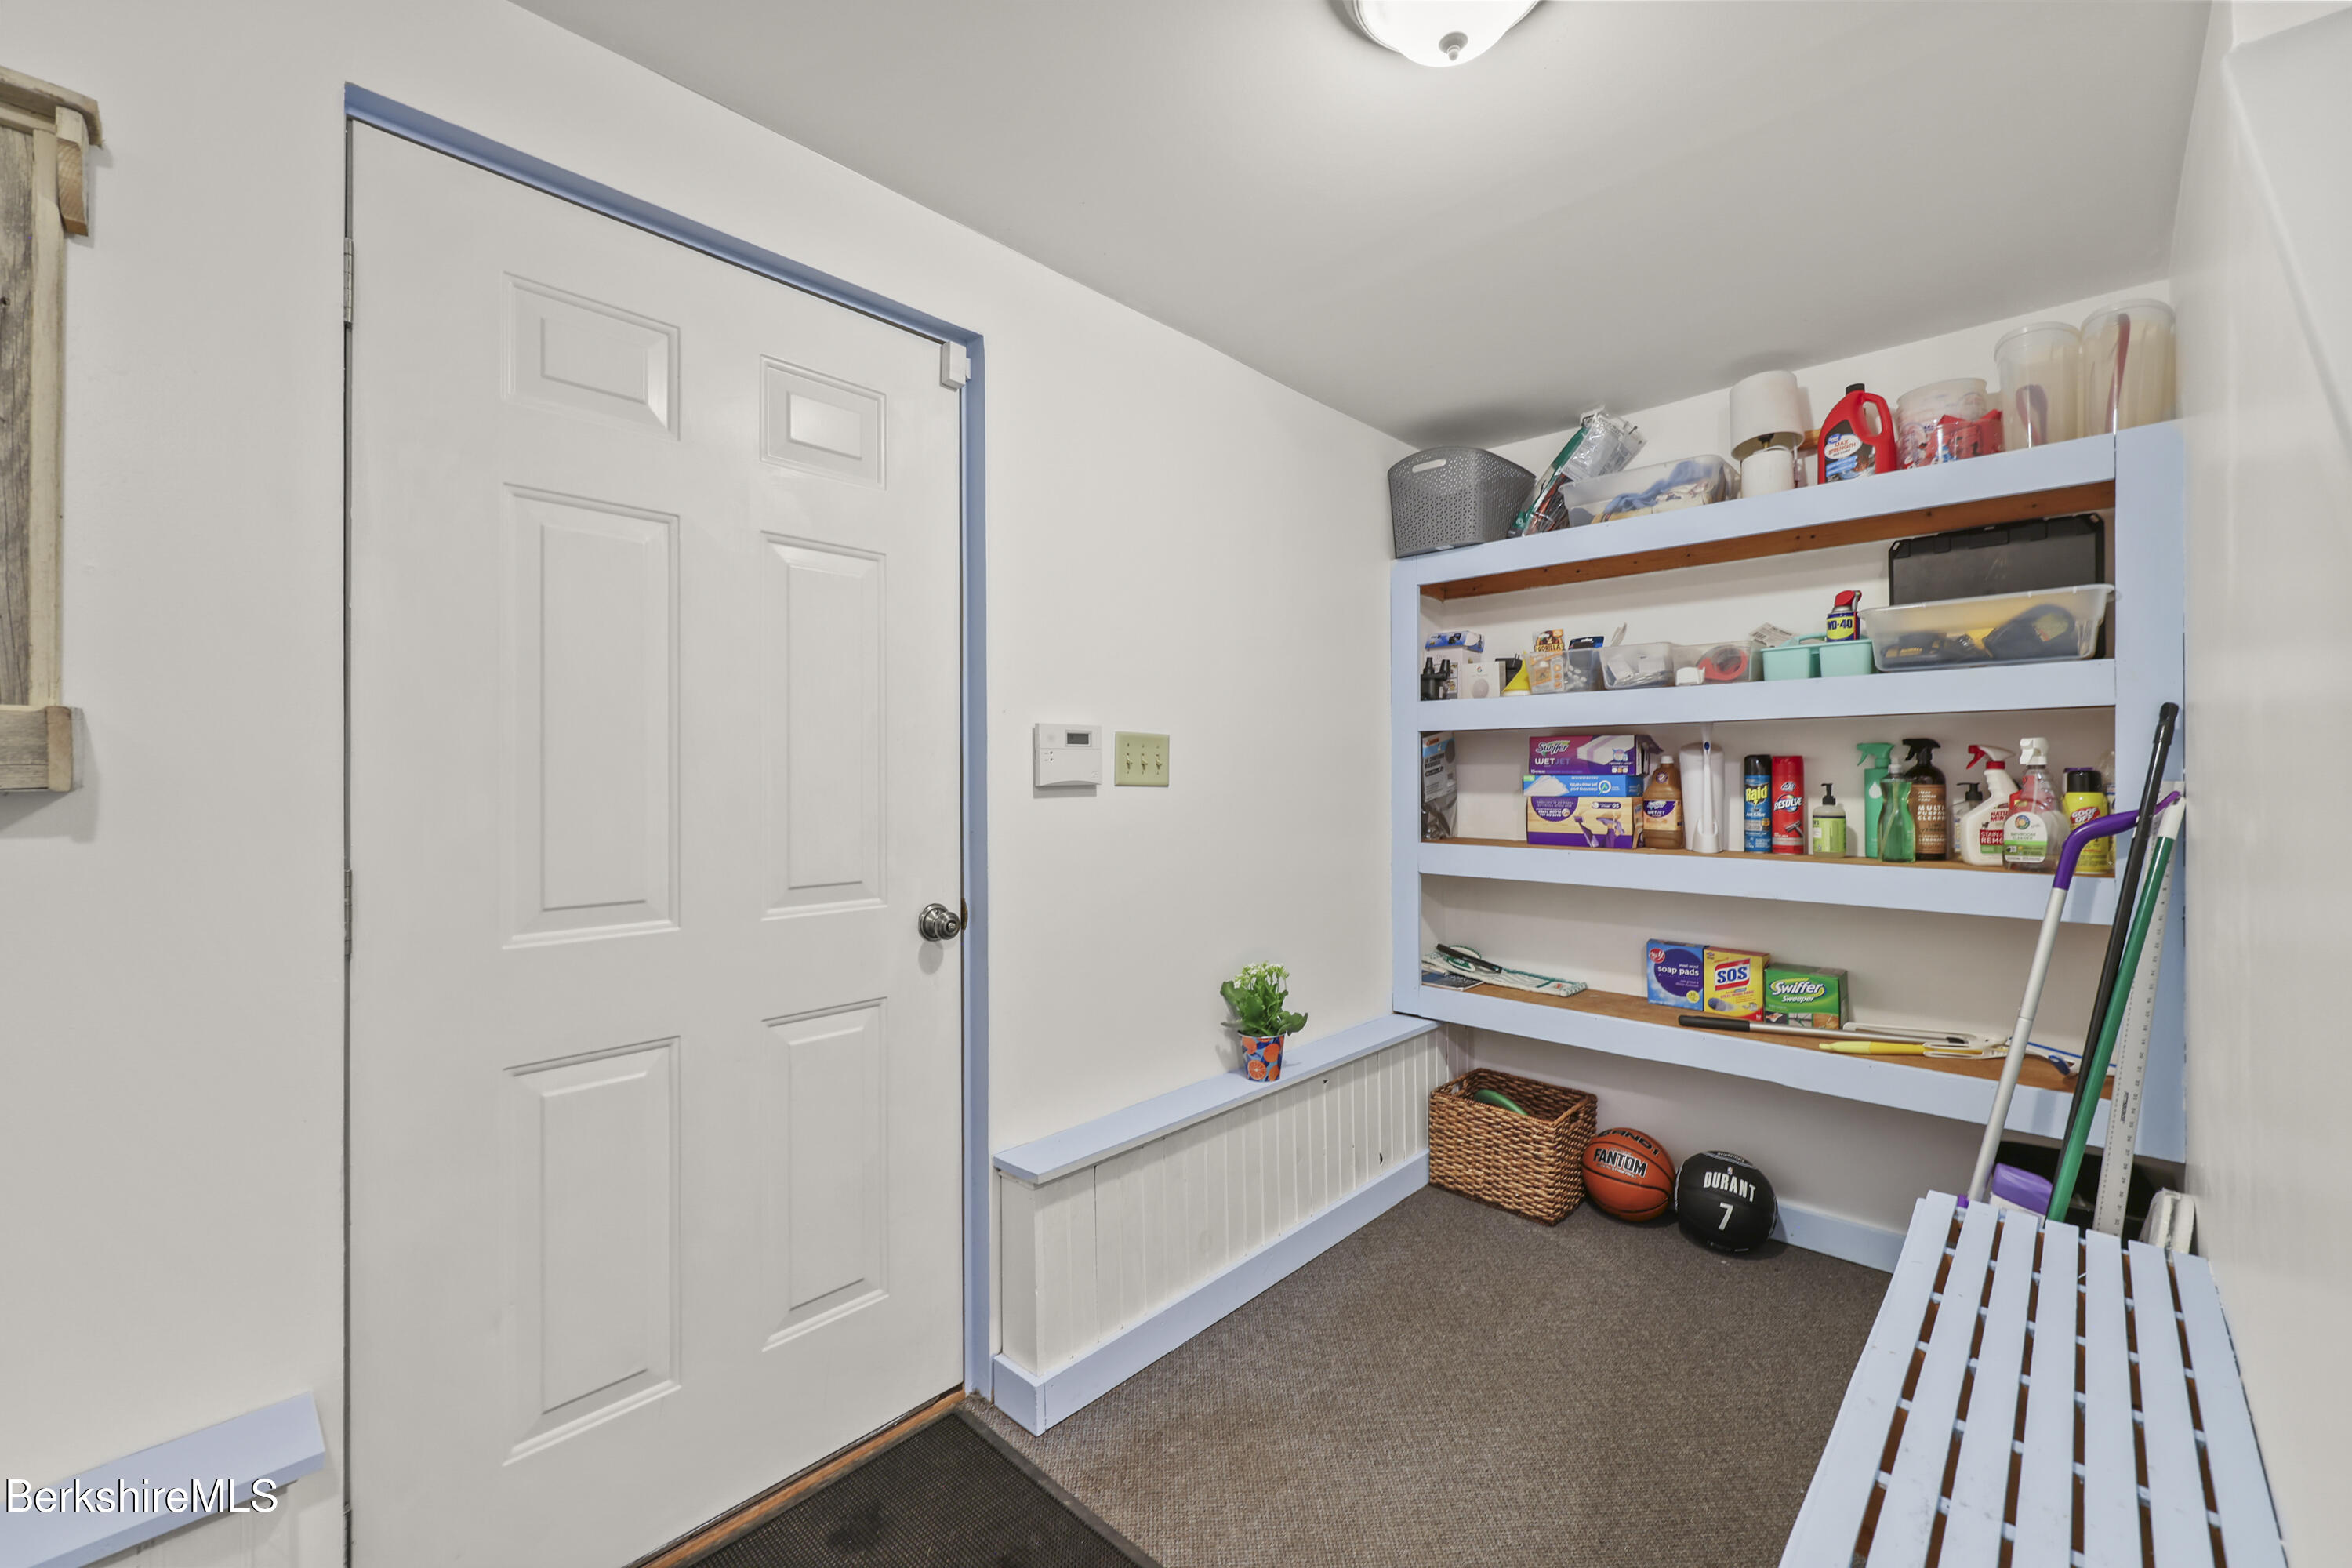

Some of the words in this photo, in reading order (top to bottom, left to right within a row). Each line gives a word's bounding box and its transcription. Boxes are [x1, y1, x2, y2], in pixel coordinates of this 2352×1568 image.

[1535, 742, 1570, 755] Swiffer
[1746, 785, 1769, 802] Raid
[1773, 797, 1802, 811] RESOLVE
[2071, 807, 2097, 818] GOOF
[2074, 815, 2094, 823] OFF
[1657, 966, 1677, 975] soap
[1772, 981, 1824, 996] Swiffer
[1593, 1148, 1648, 1178] FANTOM
[1703, 1171, 1756, 1203] DURANT
[1719, 1202, 1733, 1231] 7
